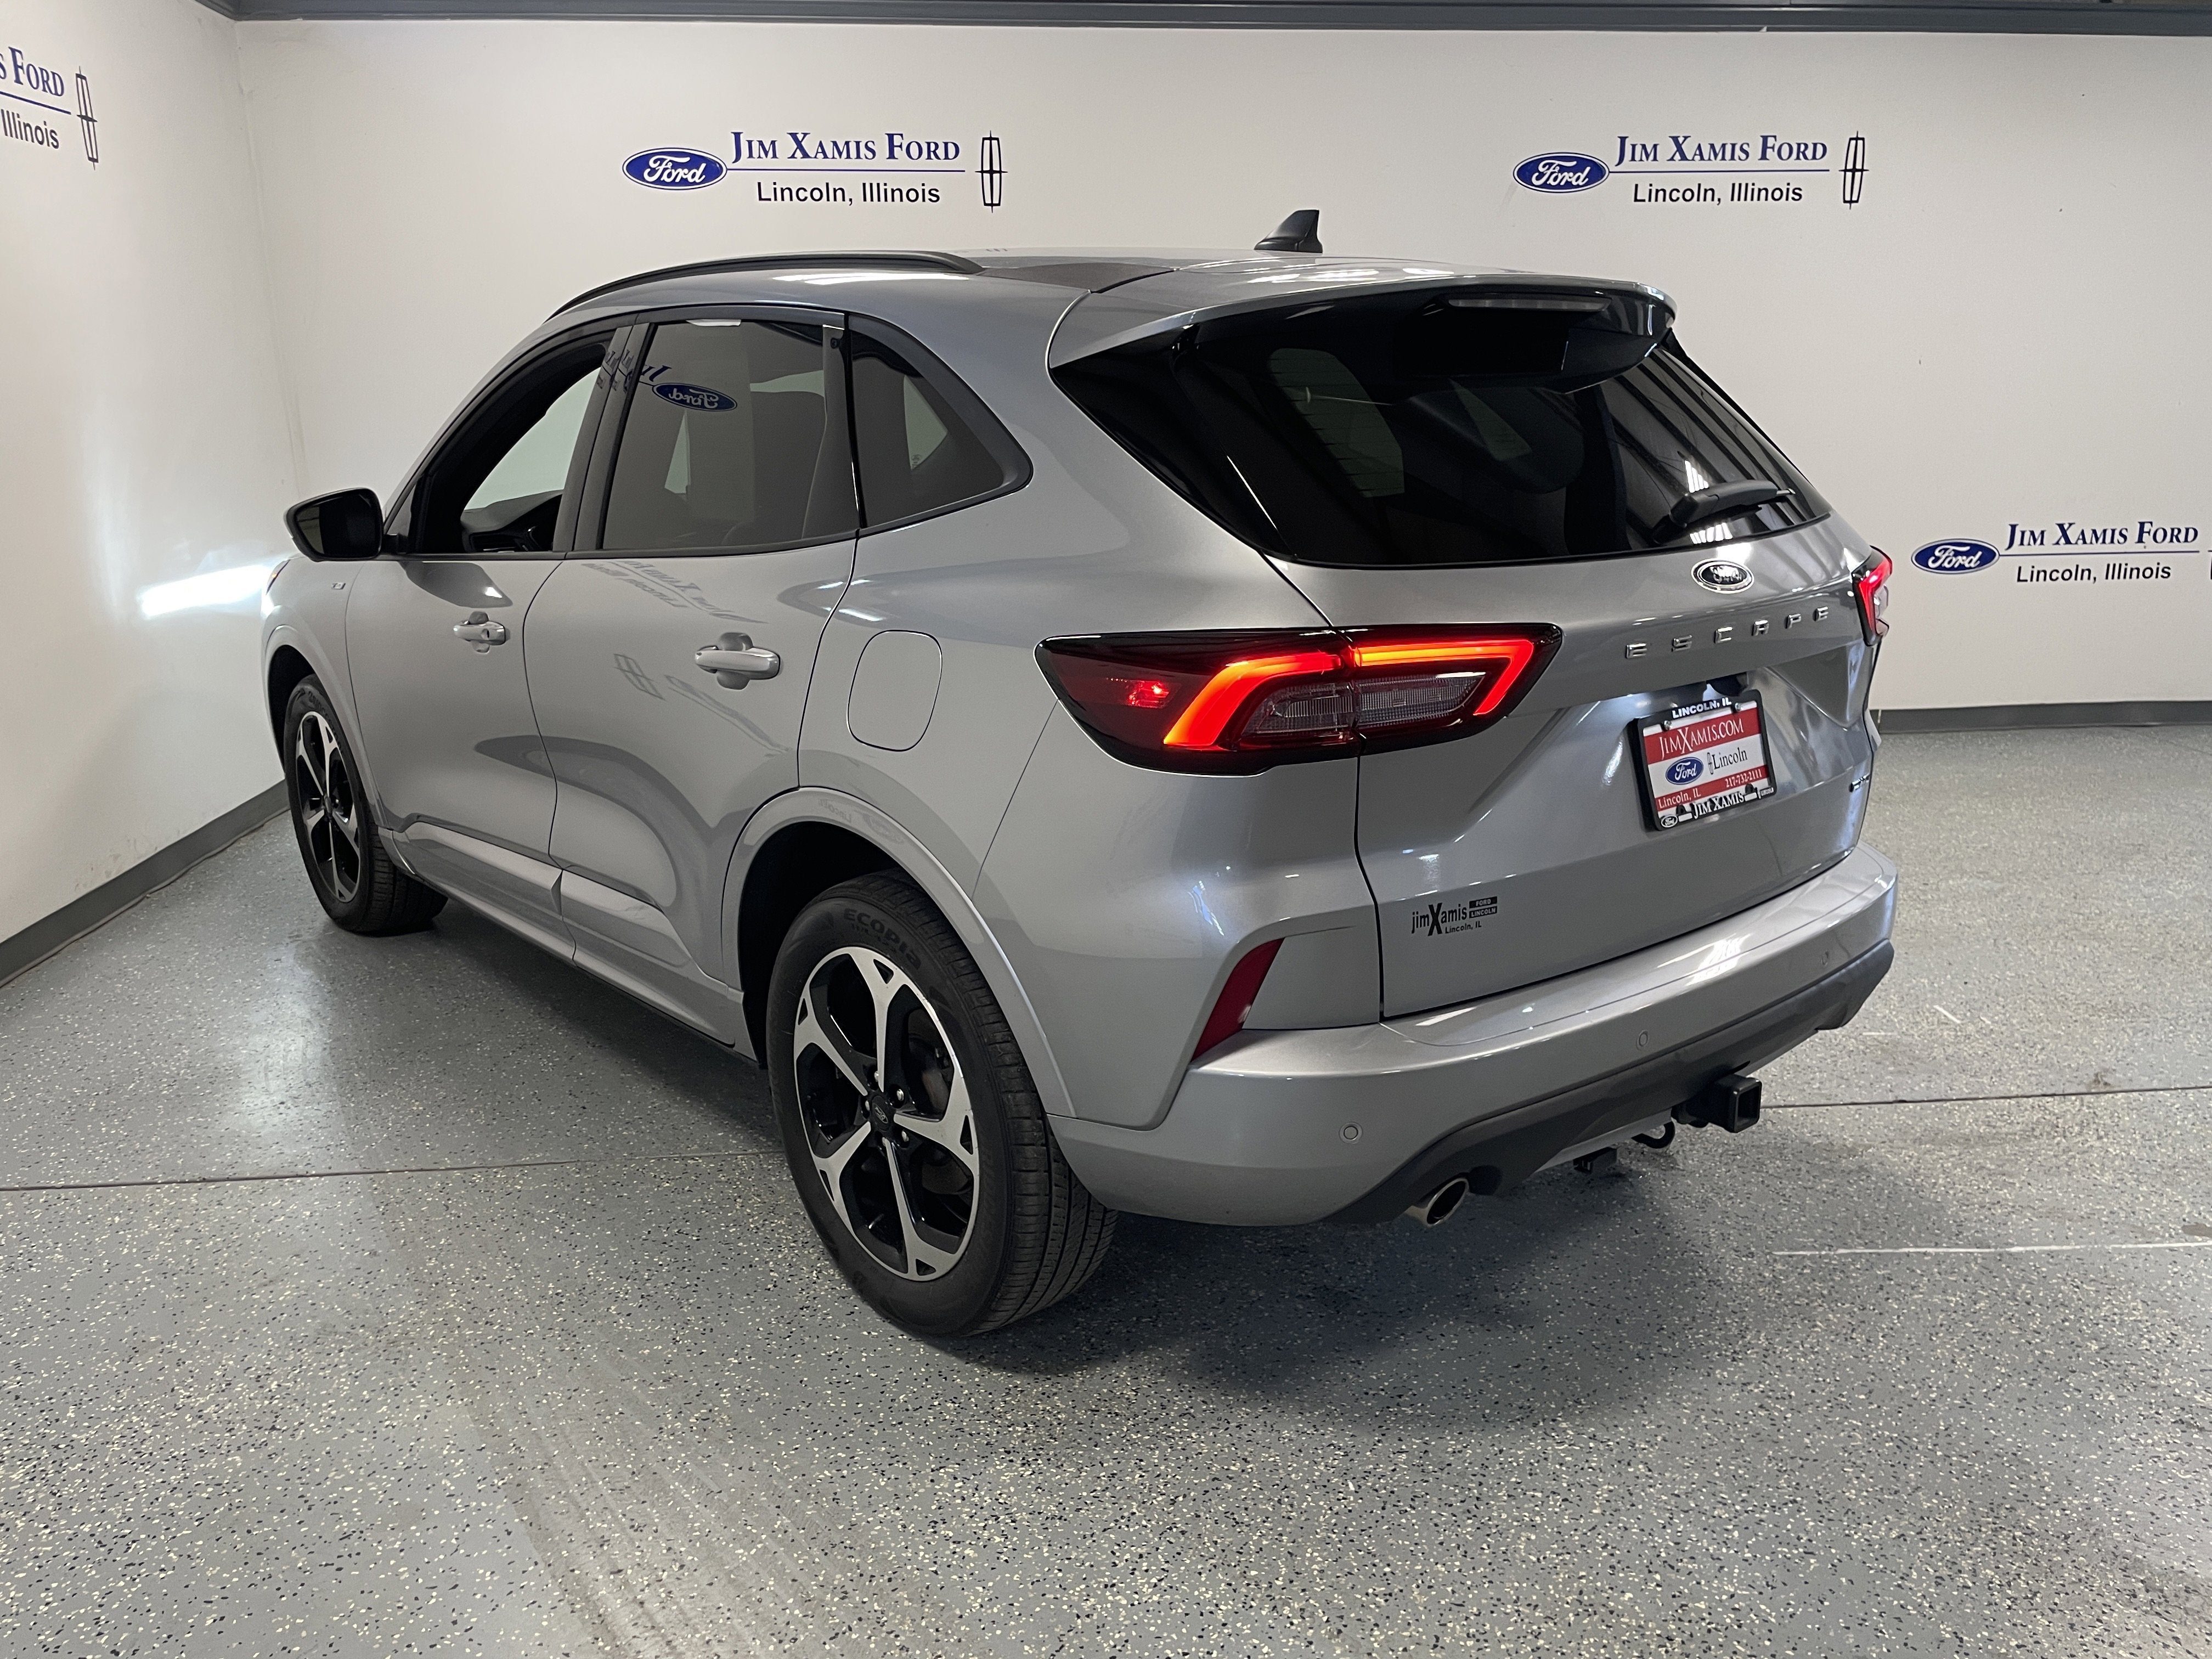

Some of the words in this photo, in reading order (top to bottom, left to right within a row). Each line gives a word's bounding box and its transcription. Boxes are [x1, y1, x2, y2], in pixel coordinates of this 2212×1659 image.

[8, 46, 65, 97] FORD
[1, 109, 60, 149] Illinois
[731, 132, 779, 164] JIM
[786, 132, 876, 160] XAMIS
[884, 133, 960, 160] FORD
[1615, 136, 1660, 167] JIM
[1666, 136, 1750, 162] XAMIS
[1758, 135, 1827, 161] FORD
[643, 155, 707, 183] Ford
[1531, 160, 1591, 186] Ford
[757, 182, 853, 206] Lincoln,
[862, 182, 940, 203] Illinois
[1633, 183, 1721, 206] Lincoln,
[1730, 182, 1803, 202] Illinois
[2005, 523, 2046, 551] JIM
[2052, 522, 2128, 545] XAMIS
[2135, 521, 2198, 544] FORD
[1928, 545, 1983, 568] Ford
[2017, 564, 2097, 584] Lincoln,
[2105, 562, 2171, 580] Illinois
[1626, 606, 1829, 658] ESCAPE
[1672, 700, 1720, 719] LINCOLN,
[1722, 697, 1732, 707] IL
[1659, 718, 1745, 760] JIMXAMIS.COM
[1674, 761, 1697, 780] Ford
[1712, 747, 1748, 771] Lincoln
[1693, 788, 1701, 797] IL
[1692, 803, 1713, 819] JIM
[1713, 792, 1745, 812] XAMIS
[1470, 907, 1497, 917] LINCOLN
[1475, 898, 1492, 907] FORD
[1445, 922, 1474, 934] Lincoln,
